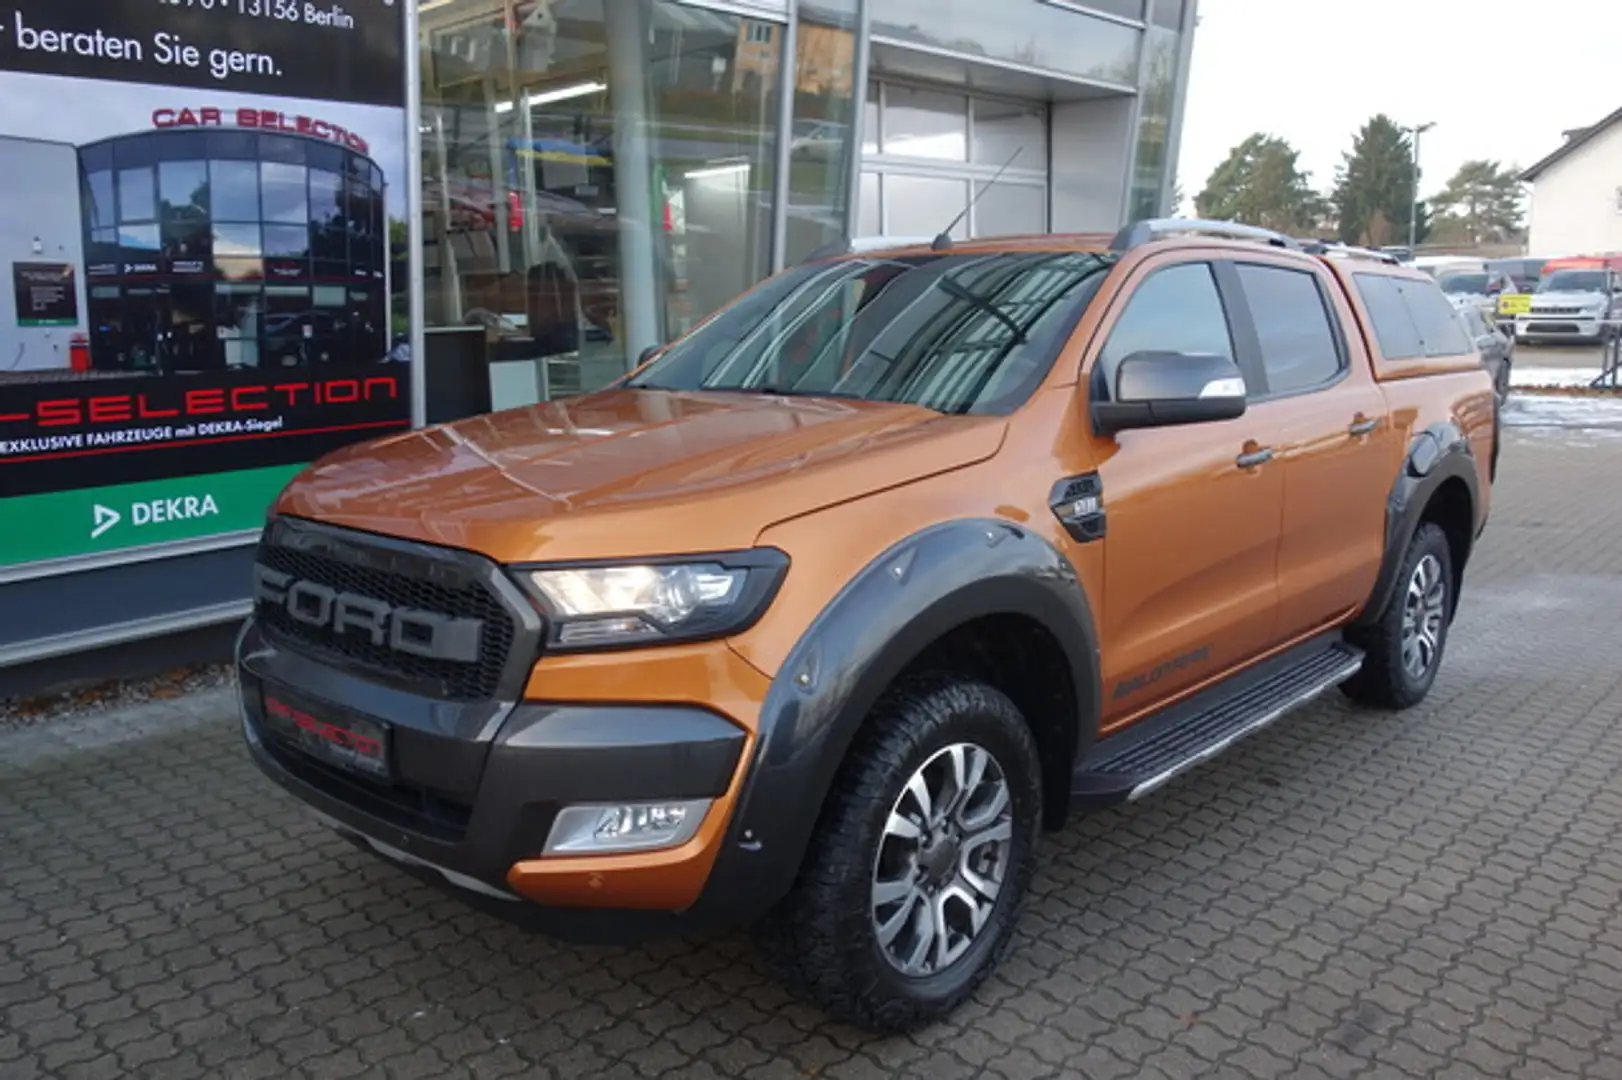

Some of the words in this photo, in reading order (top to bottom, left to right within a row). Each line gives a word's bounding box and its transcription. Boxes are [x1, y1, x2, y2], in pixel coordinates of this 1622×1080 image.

[238, 0, 300, 21] 13156
[304, 4, 354, 29] Berlin
[15, 11, 143, 60] beraten
[154, 32, 200, 66] Sie
[209, 49, 283, 79] gern.
[152, 107, 221, 127] CAR
[0, 433, 83, 454] EXKLUSIVE
[86, 426, 173, 446] FAHRZEUGE
[175, 424, 196, 437] mit
[131, 494, 219, 526] DEKRA
[254, 561, 484, 663] FORD
